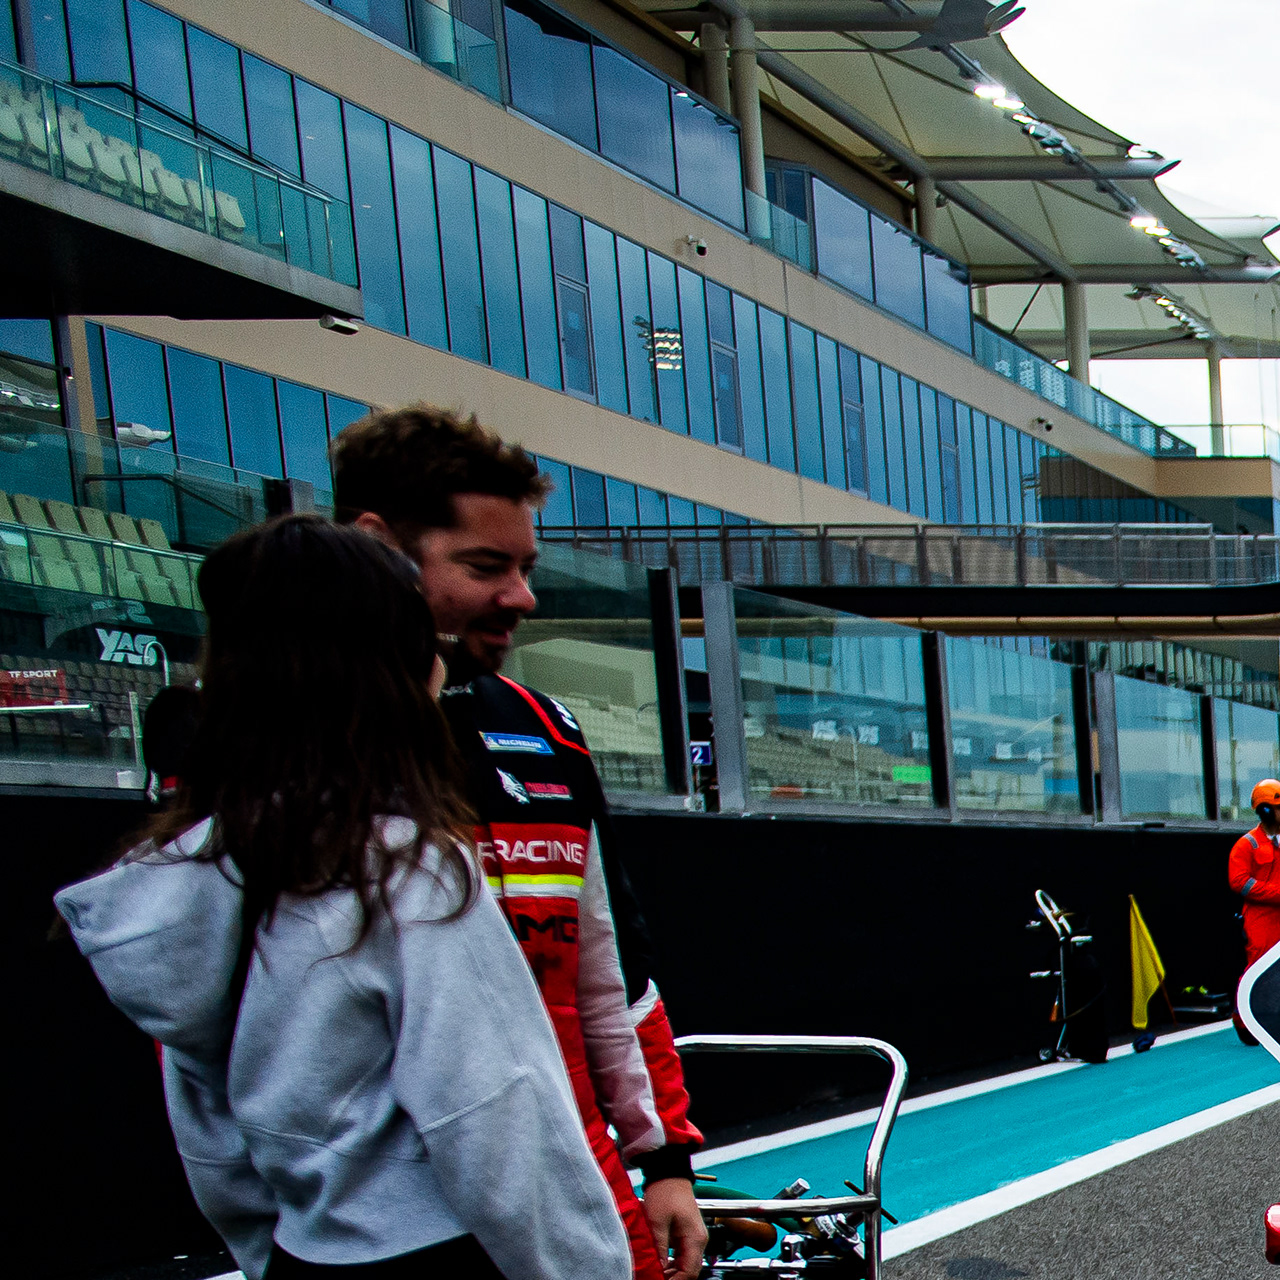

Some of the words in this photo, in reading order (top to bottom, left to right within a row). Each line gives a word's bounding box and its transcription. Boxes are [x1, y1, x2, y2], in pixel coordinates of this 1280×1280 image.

[8, 670, 21, 679] TF
[23, 669, 58, 678] SPORT
[692, 746, 704, 765] 2
